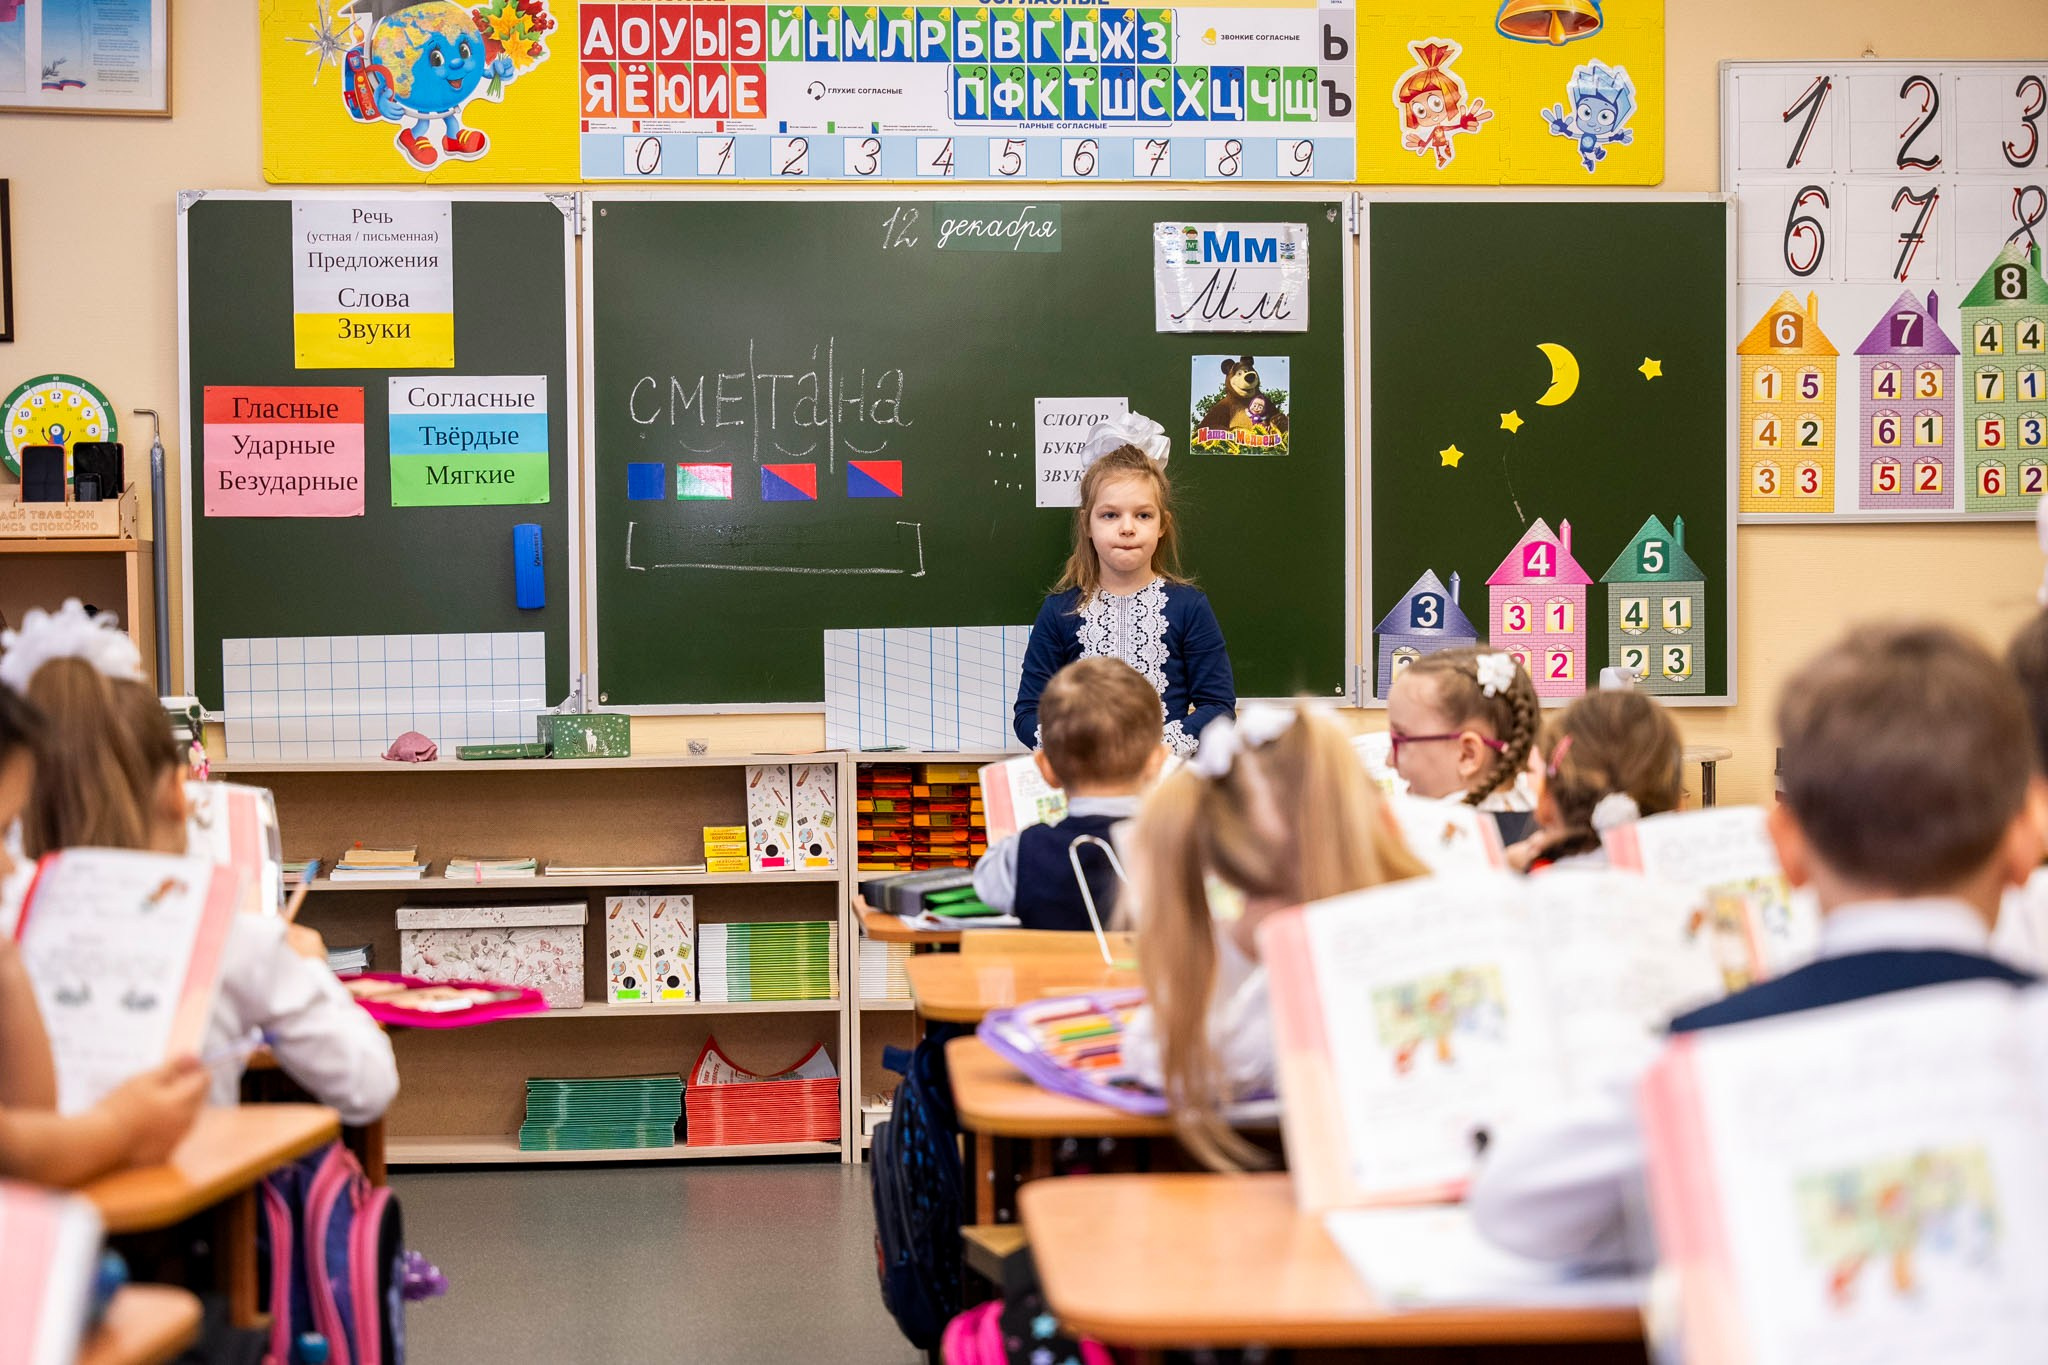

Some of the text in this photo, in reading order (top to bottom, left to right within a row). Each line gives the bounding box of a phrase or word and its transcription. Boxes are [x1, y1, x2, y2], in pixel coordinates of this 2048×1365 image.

[583, 9, 1168, 62] А О У Ы Э Й Н М Л Р Б В Г Д Ж З
[1323, 23, 1349, 61] Ь
[584, 64, 1352, 121] Я Ё Ю И Е П Ф К Т Ш С Х Ц Ч Щ Ъ
[1019, 122, 1108, 130] ПАРНЫЕ СОГЛАСНЫЕ
[1784, 75, 2047, 169] 1 2 3
[636, 137, 1314, 176] 0 1 2 3 4 5 6 7 8 9
[352, 208, 393, 224] Речь
[882, 205, 1058, 251] 12 декабря
[306, 230, 352, 244] (устная
[362, 230, 439, 244] письменная)
[1784, 185, 1830, 277] 6
[1891, 186, 1938, 280] 7
[307, 252, 439, 272] Предложения
[2000, 267, 2022, 298] 8
[337, 287, 410, 308] Слова
[337, 318, 412, 344] Звуки
[1774, 314, 1796, 345] 6
[1896, 314, 1918, 345] 7
[1980, 324, 2040, 352] 4 4
[52, 392, 62, 400] 12
[407, 387, 536, 408] Согласные
[1761, 374, 1818, 399] 1 5
[1878, 372, 1938, 398] 4 3
[1981, 372, 2037, 399] 7 1
[232, 398, 339, 420] Гласные
[418, 425, 520, 451] Твёрдые
[1198, 427, 1226, 444] Маша
[1236, 430, 1282, 447] Медведь
[1758, 421, 1818, 446] 4 2
[1878, 418, 1934, 444] 6 1
[1984, 420, 2042, 446] 5 3
[232, 434, 336, 460] Ударные
[218, 470, 358, 496] Безударные
[426, 465, 516, 486] Мягкие
[1758, 468, 1818, 494] 3 3
[1878, 465, 1938, 491] 5 2
[1984, 468, 2042, 494] 6 2
[31, 510, 95, 522] телефон
[1528, 544, 1550, 576] 4
[1642, 542, 1664, 572] 5
[1416, 595, 1438, 628] 3
[1508, 605, 1565, 630] 3 1
[1625, 600, 1681, 627] 4 1
[1551, 654, 1568, 678] 2
[1668, 648, 1684, 674] 3
